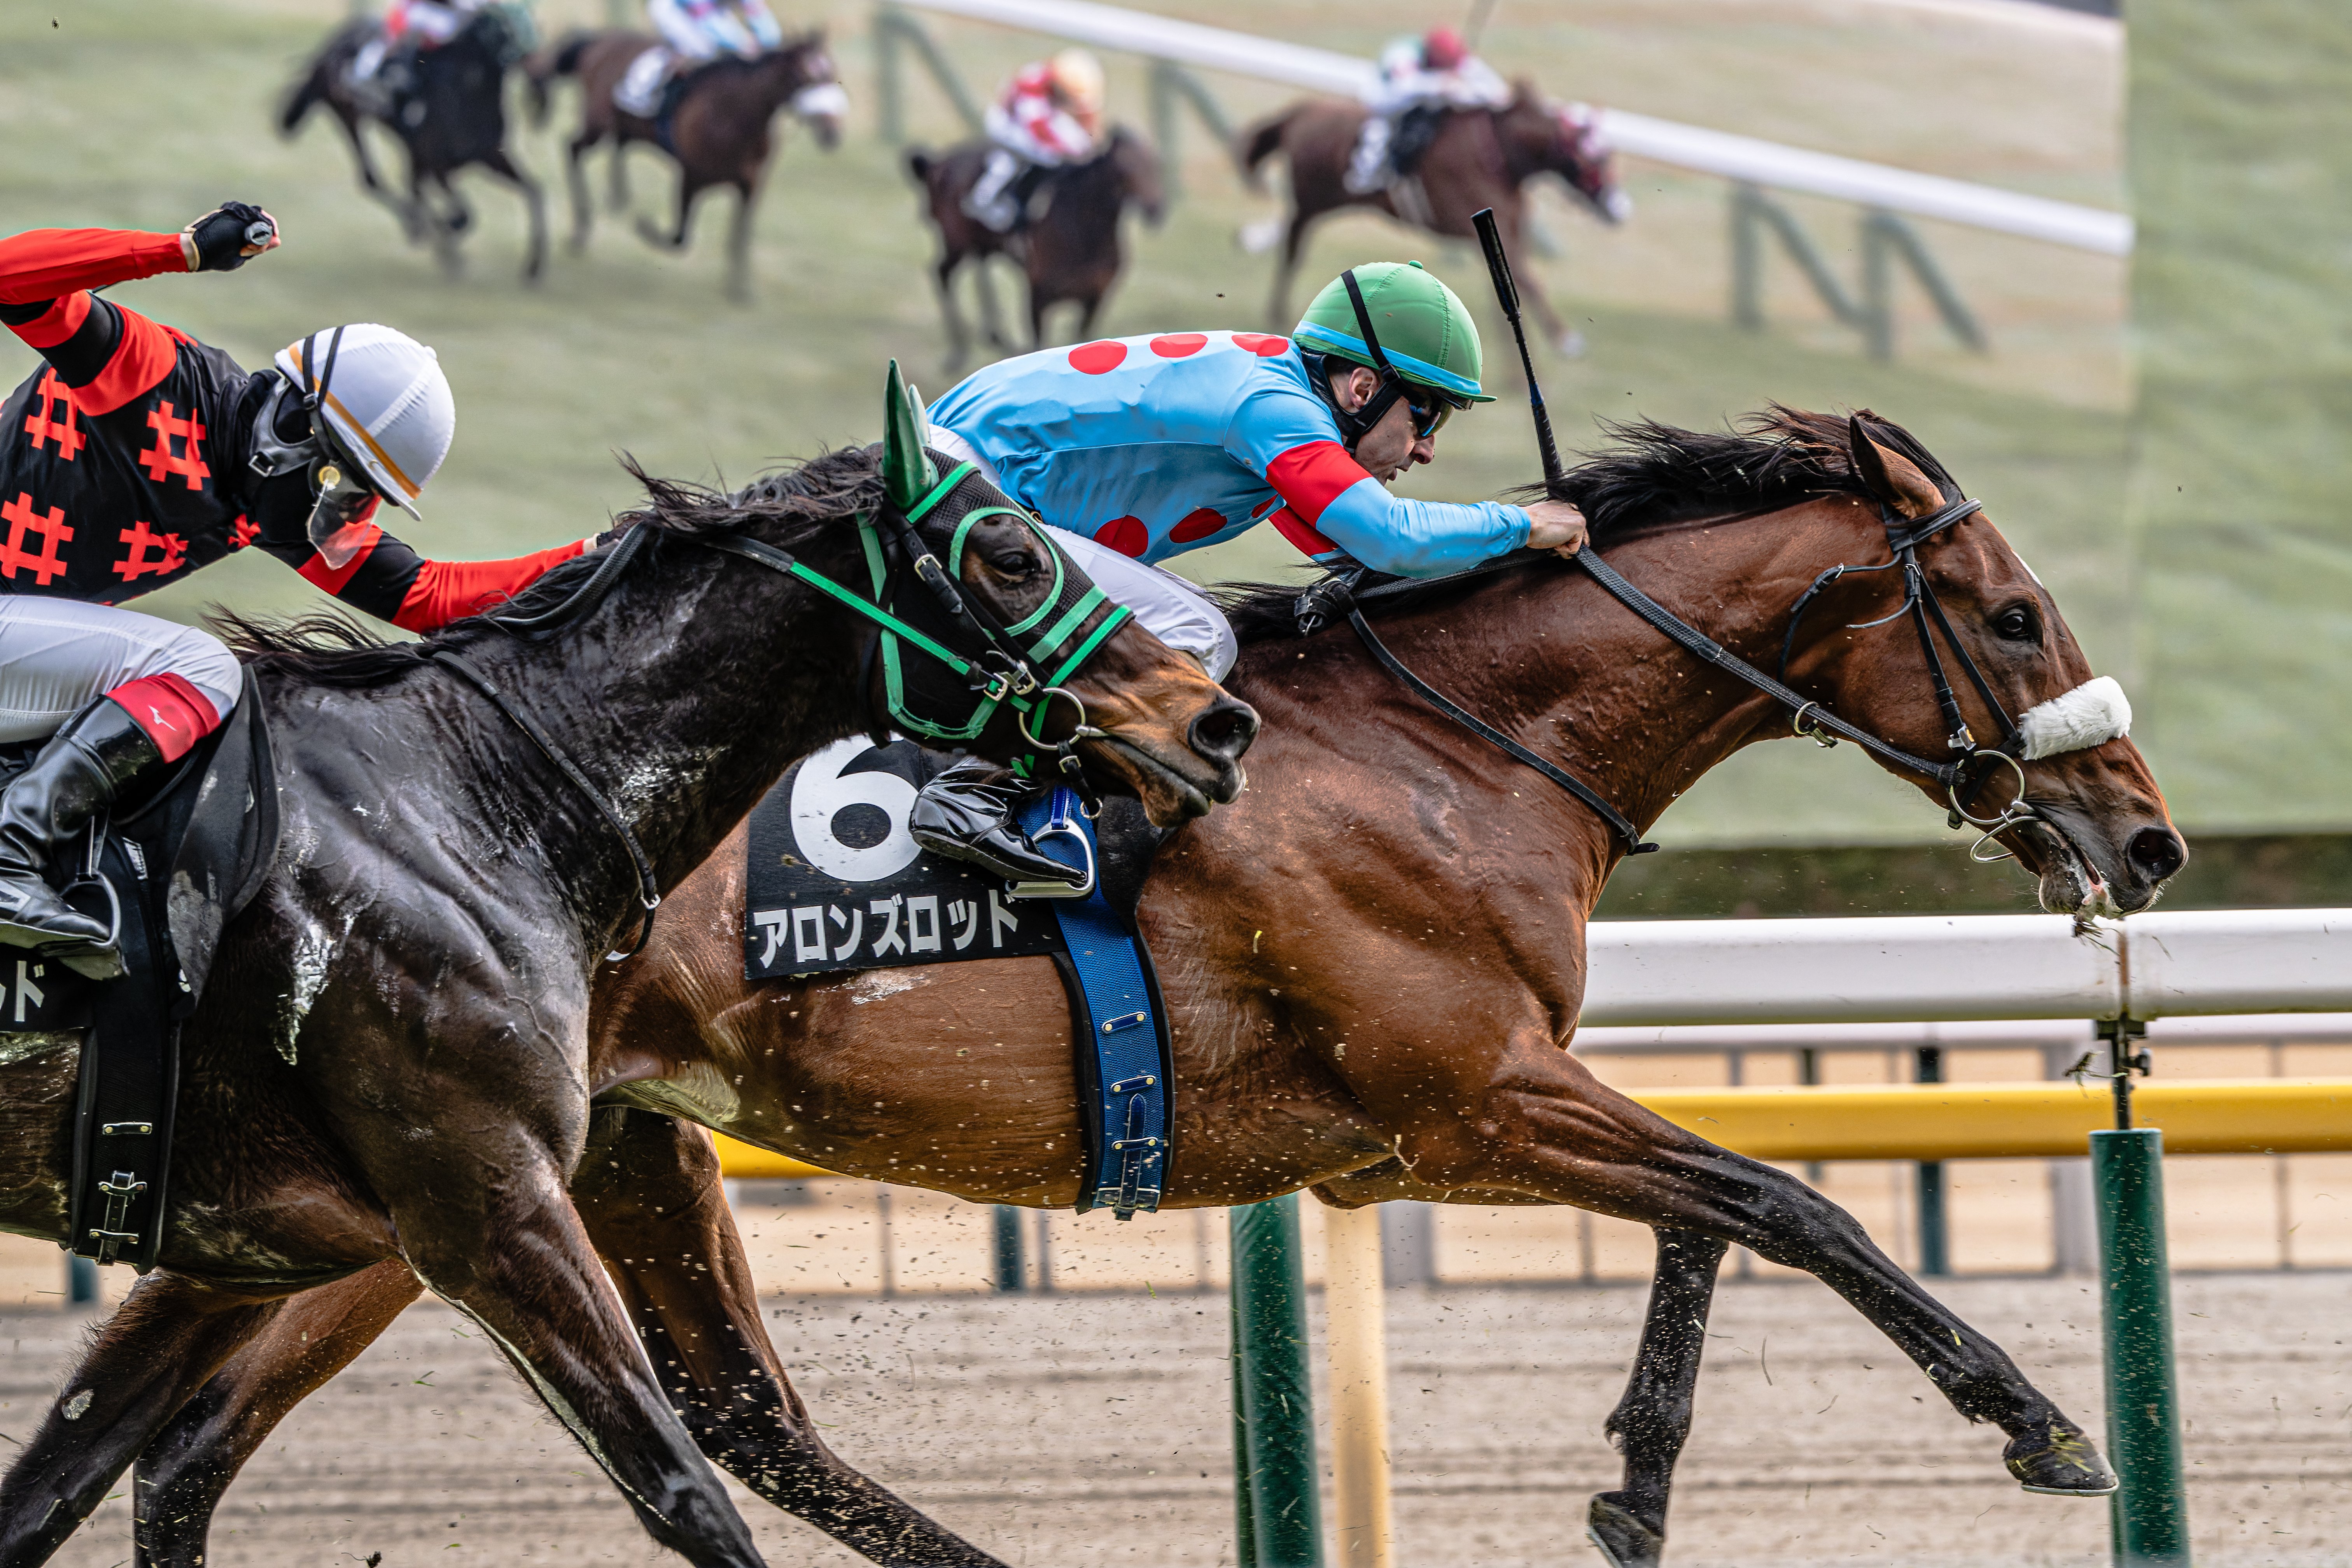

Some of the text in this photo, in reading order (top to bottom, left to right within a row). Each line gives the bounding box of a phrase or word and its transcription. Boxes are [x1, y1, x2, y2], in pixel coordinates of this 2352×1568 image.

[790, 731, 922, 882] 6
[753, 889, 1018, 969] アロンズロッド
[0, 960, 45, 1022] ド
